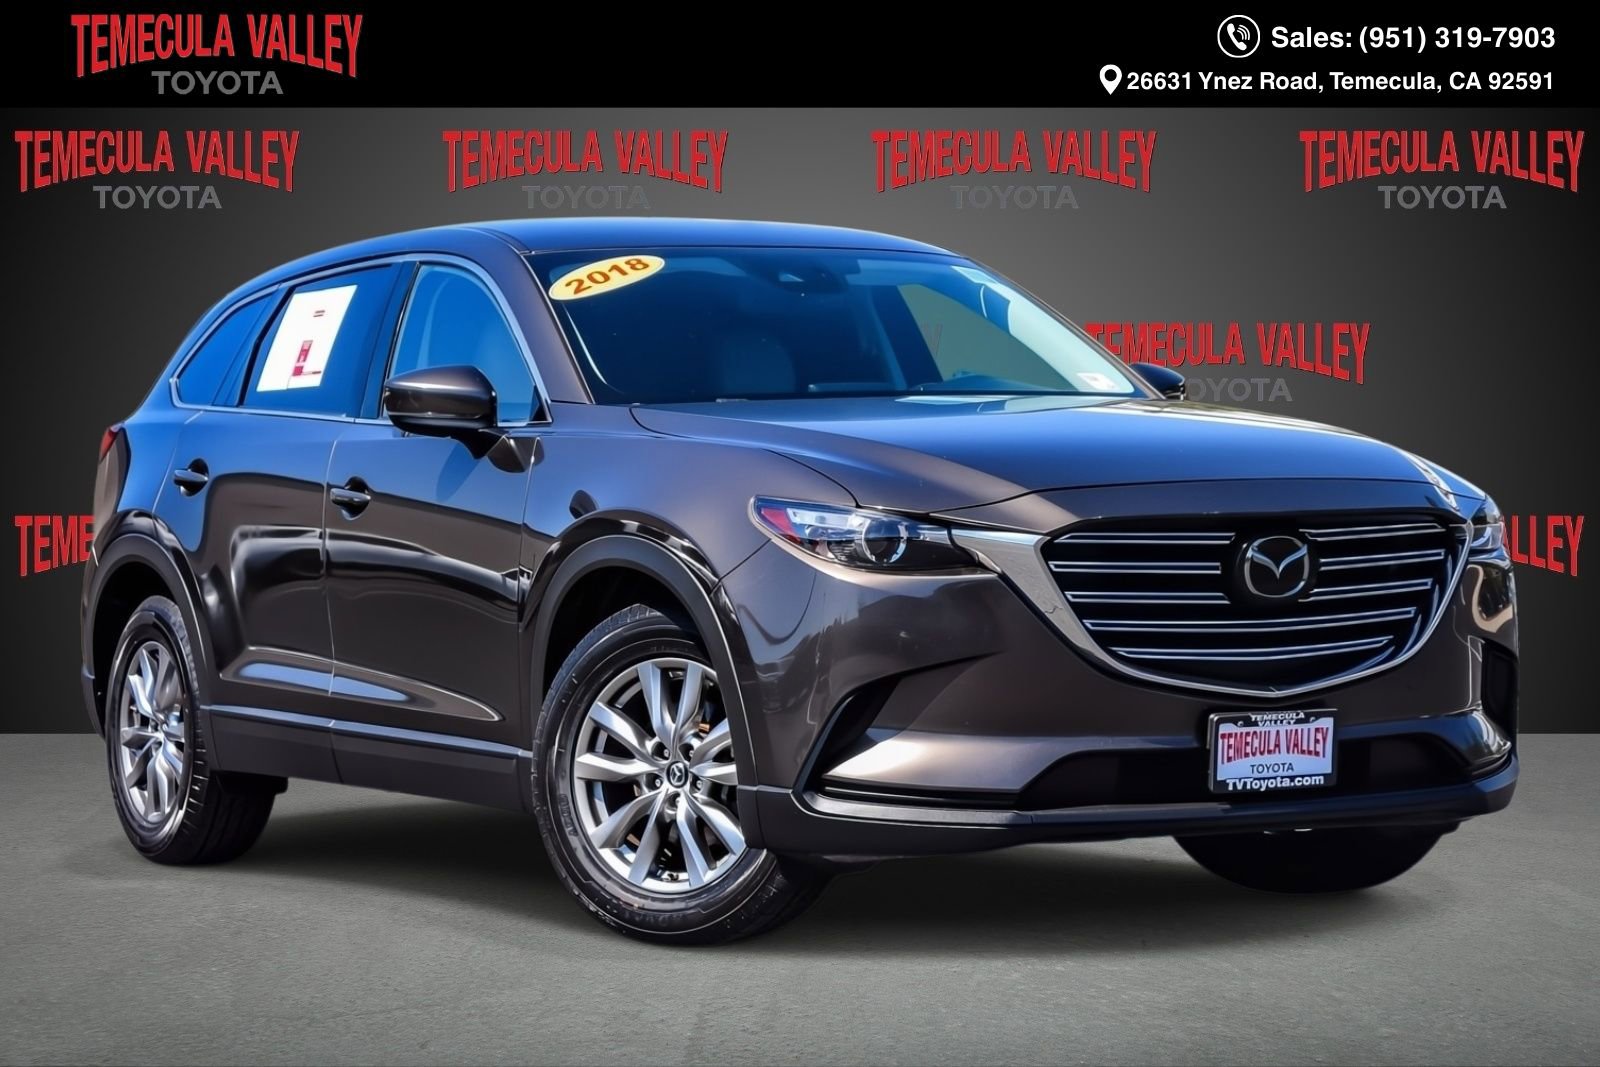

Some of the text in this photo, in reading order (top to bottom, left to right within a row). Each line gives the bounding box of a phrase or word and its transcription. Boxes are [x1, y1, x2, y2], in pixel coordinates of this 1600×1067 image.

[15, 130, 299, 192] TEMECULA VALLEY
[443, 130, 728, 192] TEMECULA VALLEY
[871, 130, 1157, 192] TEMECULA VALLEY
[1299, 130, 1583, 192] TEMECULA VALLEY
[92, 185, 222, 209] TOYOTA
[522, 185, 652, 209] TOYOTA
[950, 185, 1080, 209] TOYOTA
[1377, 185, 1507, 209] TOYOTA
[565, 258, 650, 295] 2018
[1256, 322, 1370, 384] VALLEY
[1184, 377, 1293, 402] OYOTA
[15, 515, 95, 577] TEME
[1503, 515, 1584, 577] LLEY
[1249, 711, 1305, 722] TEMECULA
[1258, 719, 1296, 727] VALLEY
[1220, 727, 1329, 765] TEMECULA VALLEY
[1226, 775, 1324, 791] TVToyota.com
[1250, 762, 1294, 774] TOYOTA
